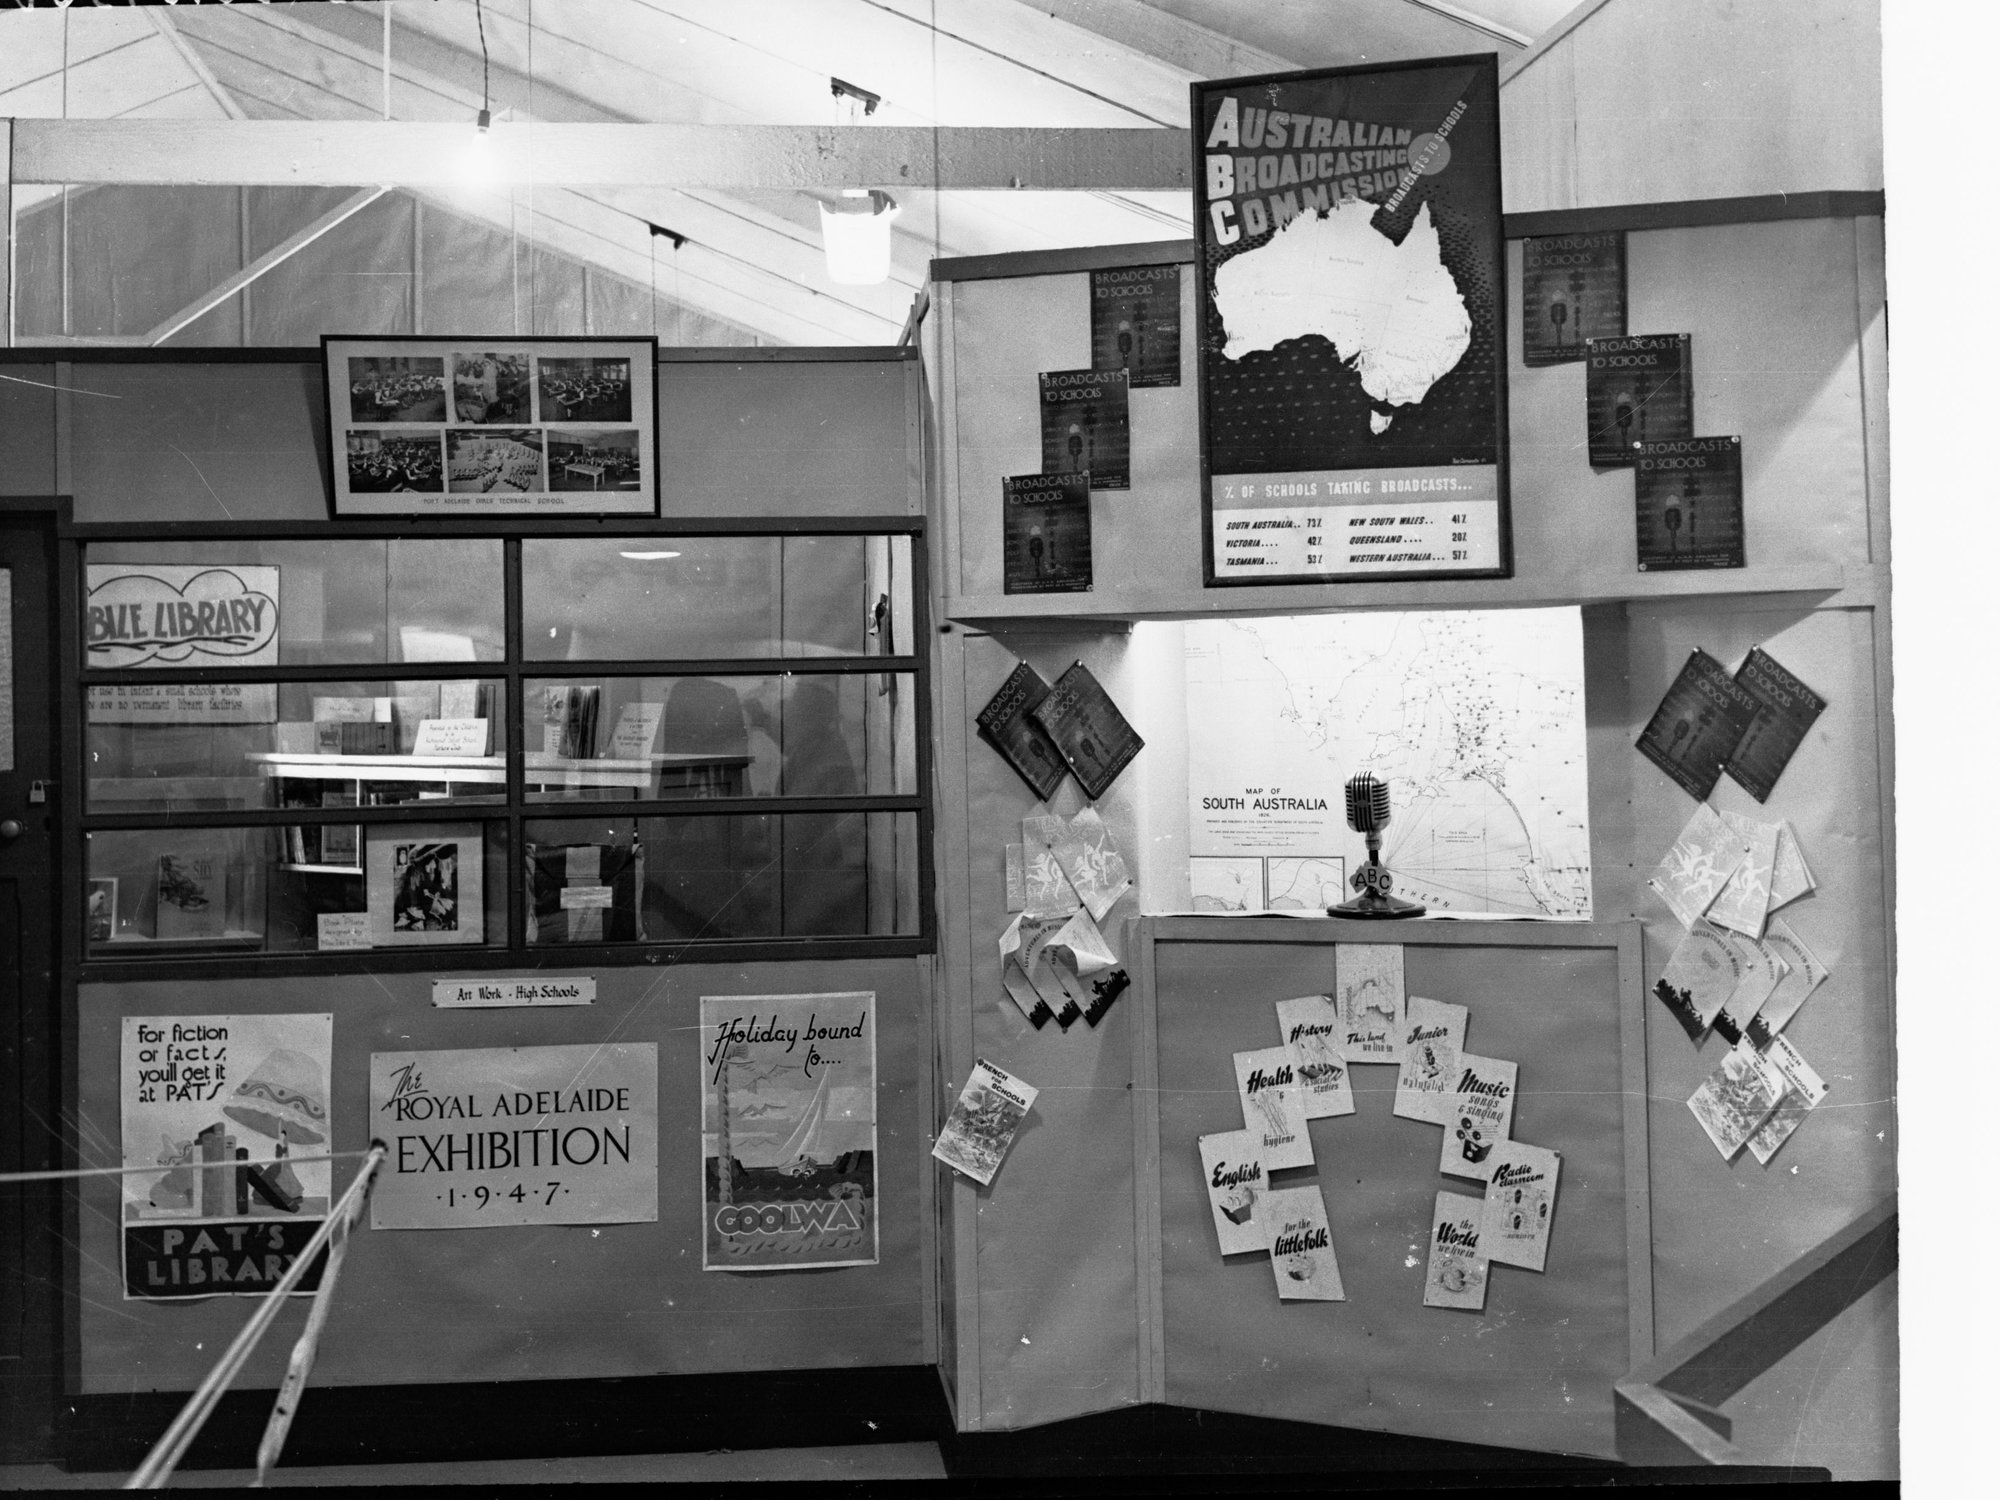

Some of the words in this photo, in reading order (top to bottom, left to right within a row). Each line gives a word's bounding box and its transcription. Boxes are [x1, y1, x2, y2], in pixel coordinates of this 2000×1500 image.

[1206, 97, 1412, 148] AUSTRALIAN
[1385, 153, 1429, 213] BROADCASTS
[1424, 141, 1439, 159] TO
[1434, 100, 1468, 143] SCHOOLS
[1206, 148, 1409, 200] BROADCASTING
[1210, 166, 1411, 246] COMMISSION
[1095, 268, 1176, 285] BROADCASTS
[1591, 337, 1683, 355] BROADCASTS
[1044, 371, 1124, 389] BROADCASTS
[1059, 387, 1102, 401] SCHOOLS
[1638, 439, 1732, 456] BROADCASTS
[1656, 455, 1706, 470] SCHOOLS
[1008, 473, 1085, 491] BROADCASTS
[1242, 485, 1255, 499] OF
[1265, 483, 1318, 498] SCHOOLS
[1328, 481, 1370, 496] TAKING
[1022, 489, 1064, 503] SCHOOLS
[1226, 522, 1251, 531] SOUTH
[1349, 518, 1366, 527] NEW
[1369, 517, 1396, 527] SOUTH
[1452, 514, 1467, 525] 41%
[1307, 536, 1322, 547] 42%
[1452, 532, 1467, 543] 20%
[1349, 553, 1386, 564] WESTERN
[154, 598, 267, 638] LIBRARY
[1751, 651, 1819, 709] BROADCASTS
[982, 665, 1029, 725] BROADCASTS
[1270, 787, 1281, 795] OF
[1202, 797, 1245, 810] SOUTH
[1253, 798, 1328, 811] AUSTRALIA
[1354, 868, 1390, 890] ABC
[1692, 929, 1727, 950] ADVENTURES
[457, 986, 473, 1001] Art
[478, 986, 502, 1001] Work
[516, 985, 540, 1004] High
[540, 985, 580, 1000] Schools
[137, 1024, 165, 1044] for
[172, 1023, 228, 1042] fiction
[1290, 1023, 1333, 1044] History
[1347, 1031, 1366, 1045] This
[1367, 1031, 1386, 1042] land
[1407, 1025, 1449, 1045] Junior
[139, 1050, 159, 1063] or
[707, 1014, 798, 1086] Holiday
[802, 1011, 867, 1041] bound
[1363, 1043, 1372, 1052] we
[1373, 1041, 1385, 1052] live
[1386, 1043, 1394, 1053] in
[1776, 1037, 1802, 1067] FRENCH
[181, 1065, 211, 1089] get
[215, 1063, 227, 1080] it
[1247, 1065, 1293, 1094] Health
[1457, 1068, 1511, 1098] Music
[1784, 1065, 1815, 1100] SCHOOLS
[139, 1087, 157, 1103] at
[166, 1081, 225, 1102] PAT'S
[381, 1061, 428, 1111] The
[991, 1083, 1026, 1106] SCHOOLS
[396, 1095, 482, 1122] ROYAL
[492, 1087, 630, 1118] ADELAIDE
[1468, 1094, 1500, 1109] songs
[1466, 1105, 1504, 1123] singing
[397, 1126, 631, 1174] EXHIBITION
[1263, 1132, 1296, 1149] hygiene
[1212, 1161, 1262, 1190] English
[1492, 1163, 1532, 1184] Radio
[1499, 1173, 1545, 1188] classroom
[1284, 1221, 1297, 1235] for
[1298, 1219, 1311, 1230] the
[1460, 1219, 1474, 1230] the
[163, 1223, 285, 1256] PAT'S
[1436, 1222, 1480, 1248] World
[1438, 1245, 1450, 1253] we
[1451, 1245, 1465, 1256] live
[1465, 1249, 1475, 1258] in
